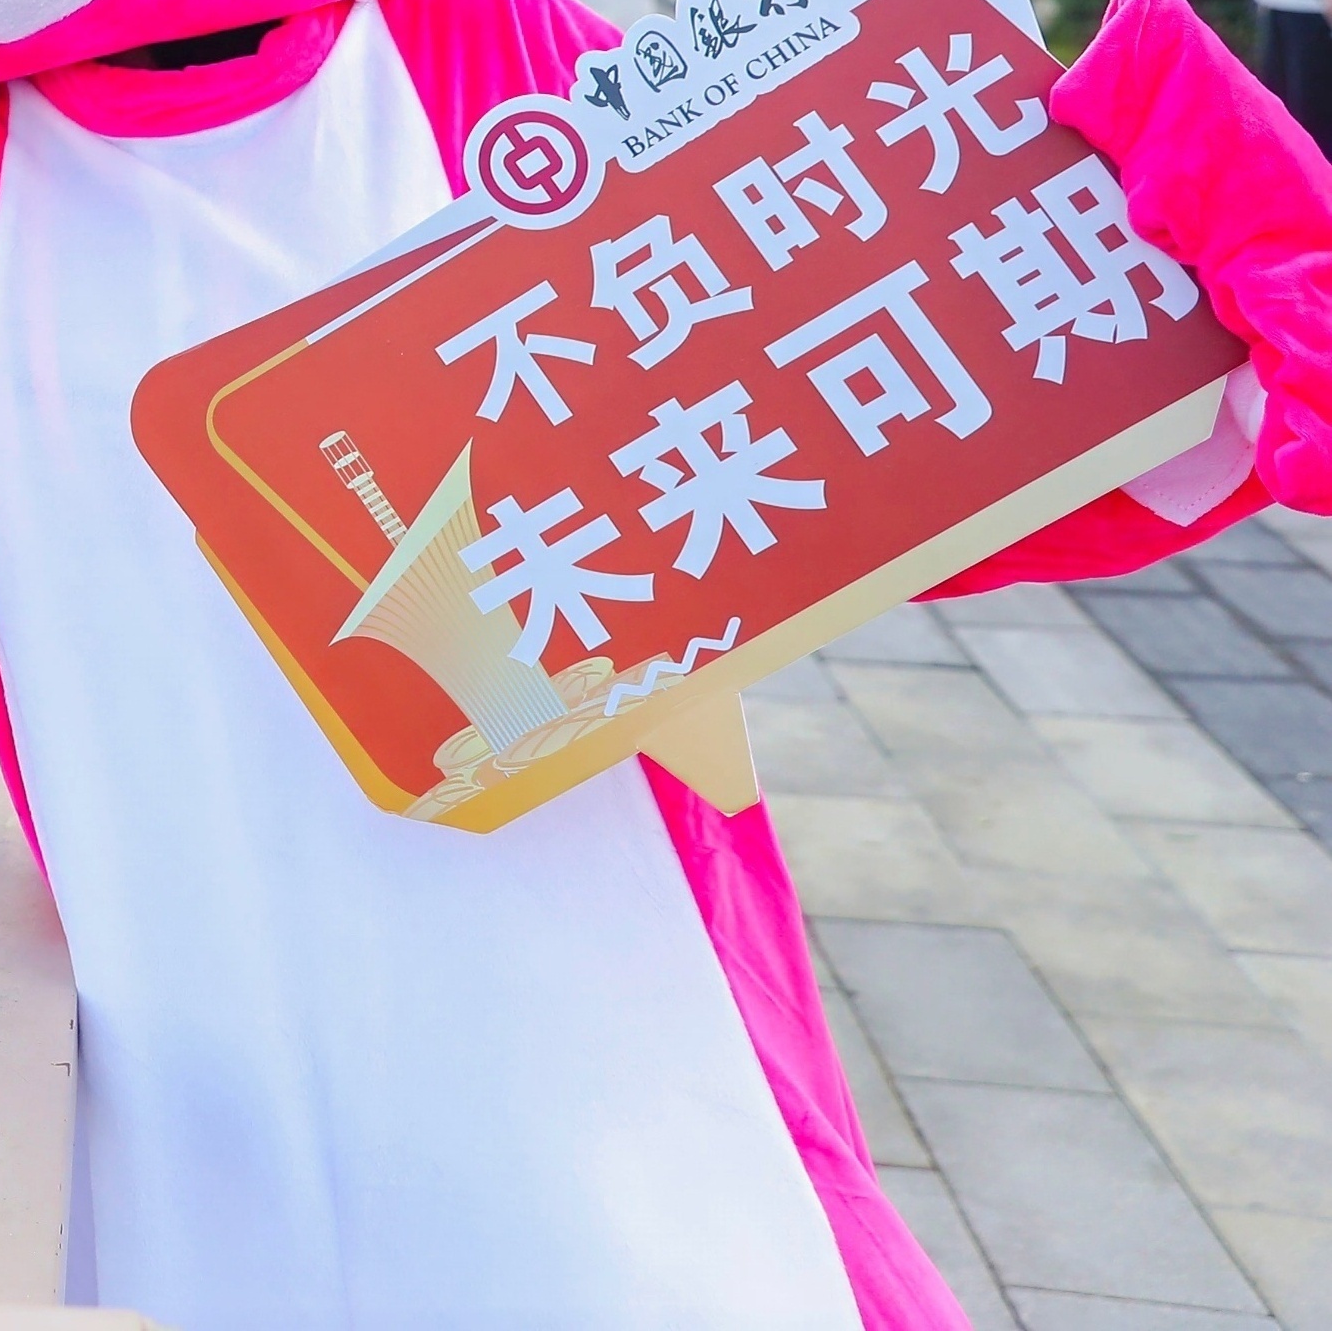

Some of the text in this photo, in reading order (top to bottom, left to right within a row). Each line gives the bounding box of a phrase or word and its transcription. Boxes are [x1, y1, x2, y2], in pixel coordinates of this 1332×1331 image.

[435, 32, 1049, 428] 不负时光
[620, 15, 842, 159] BANK OF CHINA
[456, 153, 1200, 668] 未来可期
